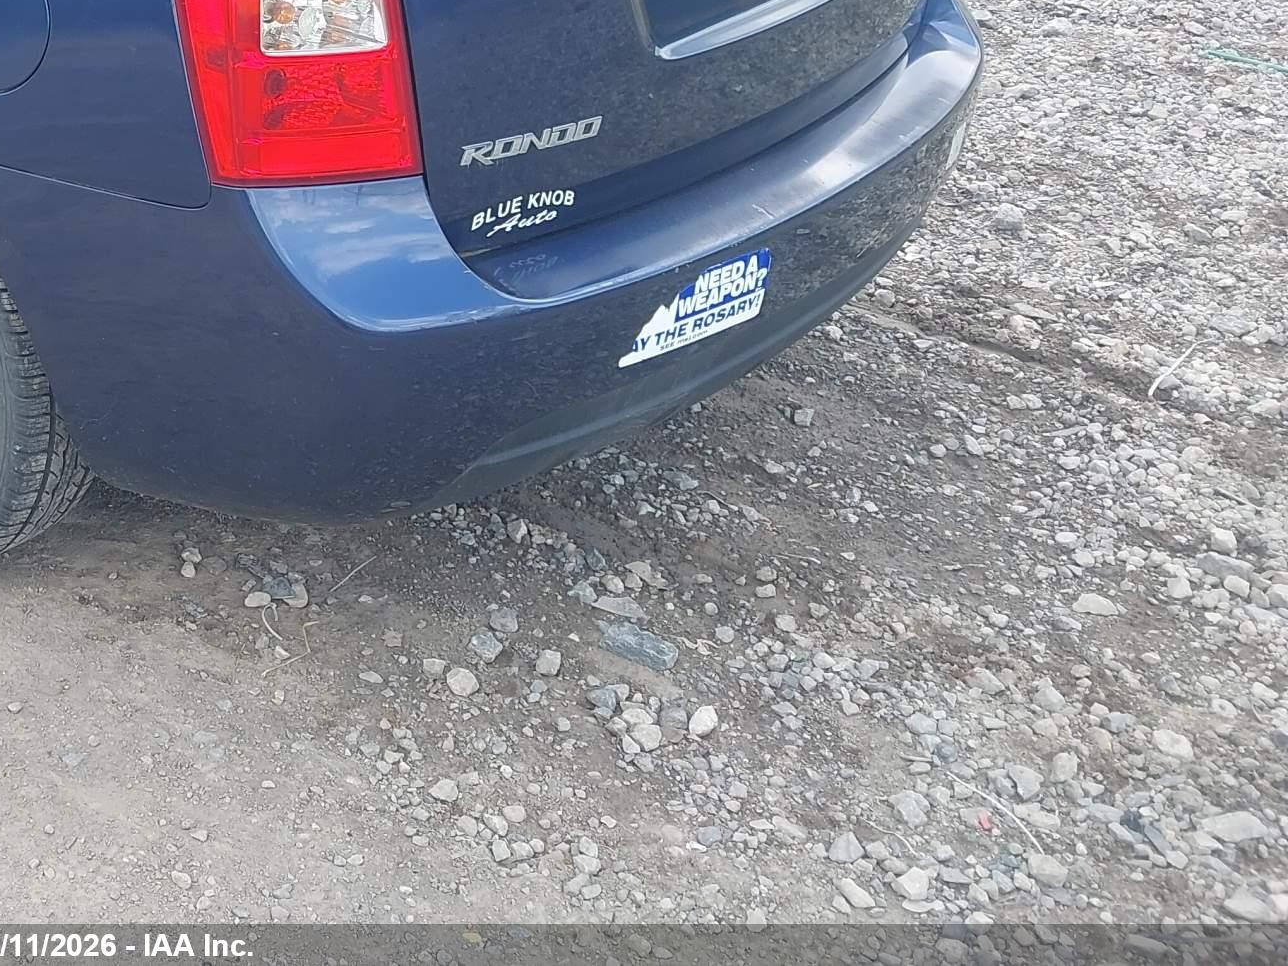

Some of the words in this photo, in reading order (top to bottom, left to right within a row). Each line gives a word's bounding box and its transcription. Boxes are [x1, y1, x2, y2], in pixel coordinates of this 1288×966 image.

[460, 115, 603, 167] RONDO
[471, 196, 523, 231] BLUE
[527, 190, 575, 210] KNOB
[486, 209, 558, 238] Auto
[678, 268, 769, 318] WEAPON?
[694, 260, 745, 295] NEED
[746, 255, 759, 276] A
[654, 322, 689, 346] THE
[692, 294, 761, 331] ROSARY!
